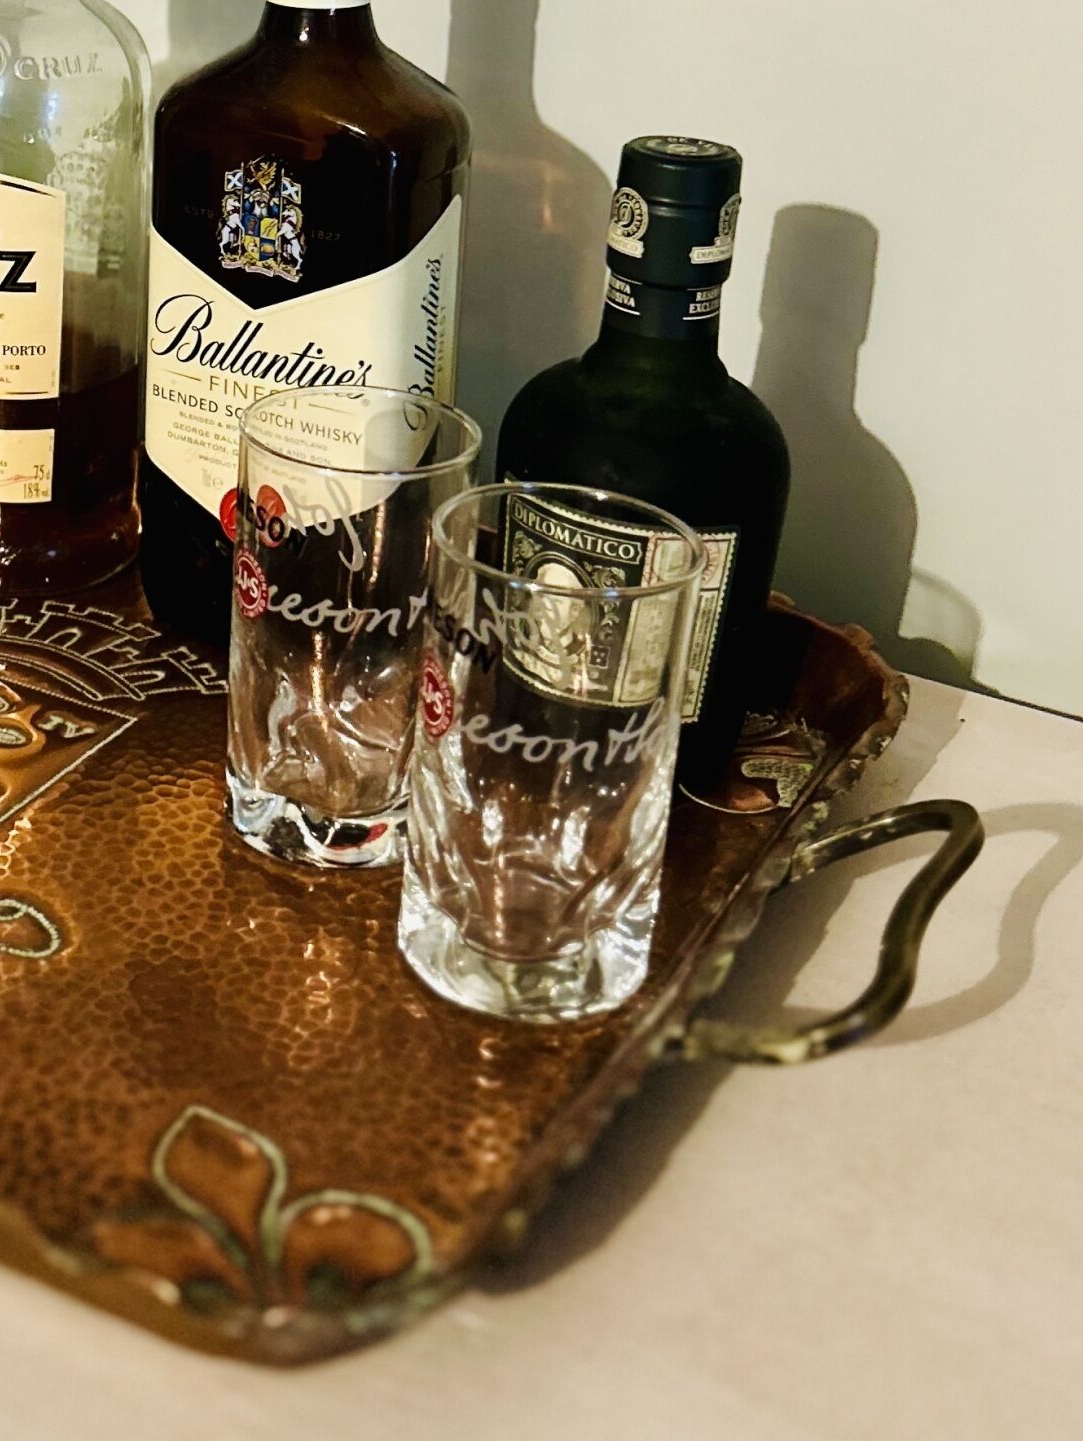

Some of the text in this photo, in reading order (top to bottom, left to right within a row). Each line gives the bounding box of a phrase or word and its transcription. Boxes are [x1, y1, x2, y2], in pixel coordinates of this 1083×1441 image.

[14, 53, 103, 80] CRUZ
[2, 344, 47, 357] PORTO
[150, 293, 373, 390] Ballantine's
[405, 258, 442, 428] Ballantine's
[152, 383, 219, 413] BLENDED
[300, 421, 363, 446] WHISKY
[179, 410, 215, 426] BLENDED
[172, 421, 211, 438] GEORGE
[34, 464, 45, 481] 75
